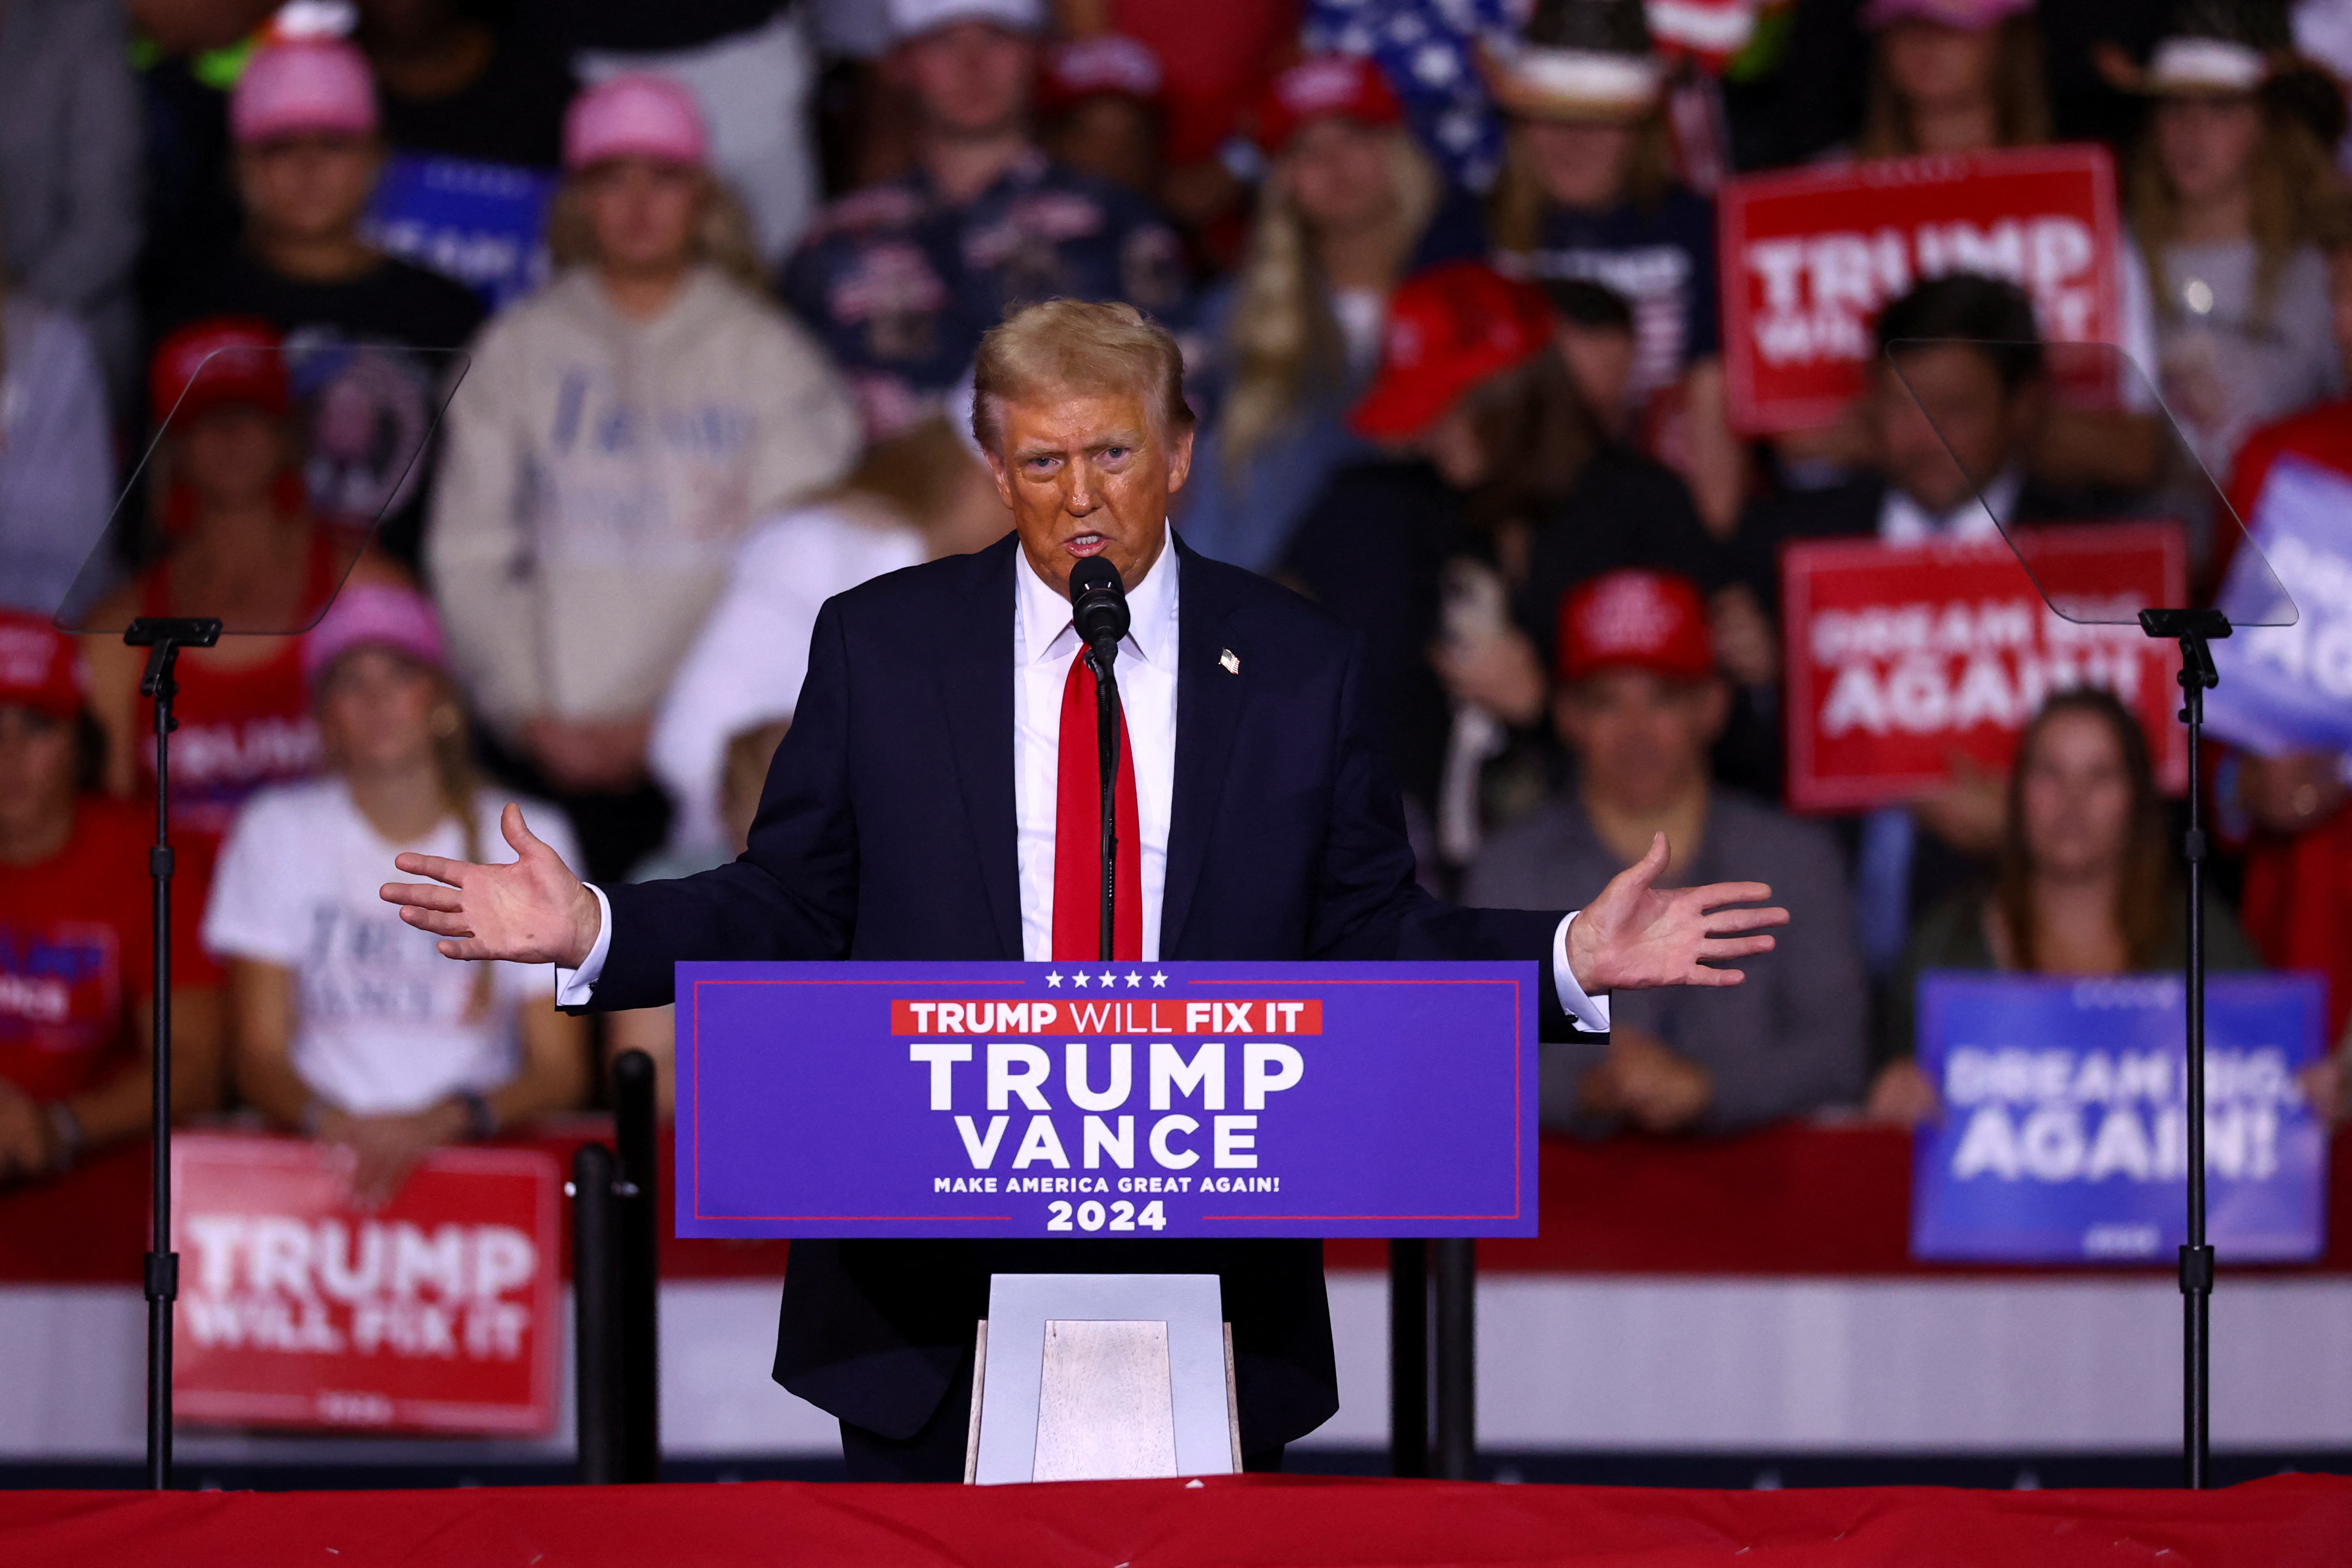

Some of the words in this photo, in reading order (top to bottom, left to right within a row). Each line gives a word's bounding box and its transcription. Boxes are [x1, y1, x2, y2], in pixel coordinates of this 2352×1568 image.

[910, 1002, 1058, 1034] TRUMP
[1069, 1002, 1172, 1033] WILL
[1186, 1002, 1253, 1033] FIX
[1266, 1002, 1304, 1033] IT
[909, 1043, 1304, 1112] TRUMP
[954, 1114, 1258, 1170] VANCE
[934, 1177, 998, 1193] MAKE
[1005, 1177, 1110, 1193] AMERICA
[1117, 1177, 1192, 1193] GREAT
[1199, 1176, 1280, 1193] AGAIN!
[1047, 1200, 1167, 1231] 2024
[185, 1212, 538, 1300] TRUMP
[186, 1296, 346, 1354] WILL
[352, 1302, 456, 1358] FIX
[463, 1305, 532, 1361] IT
